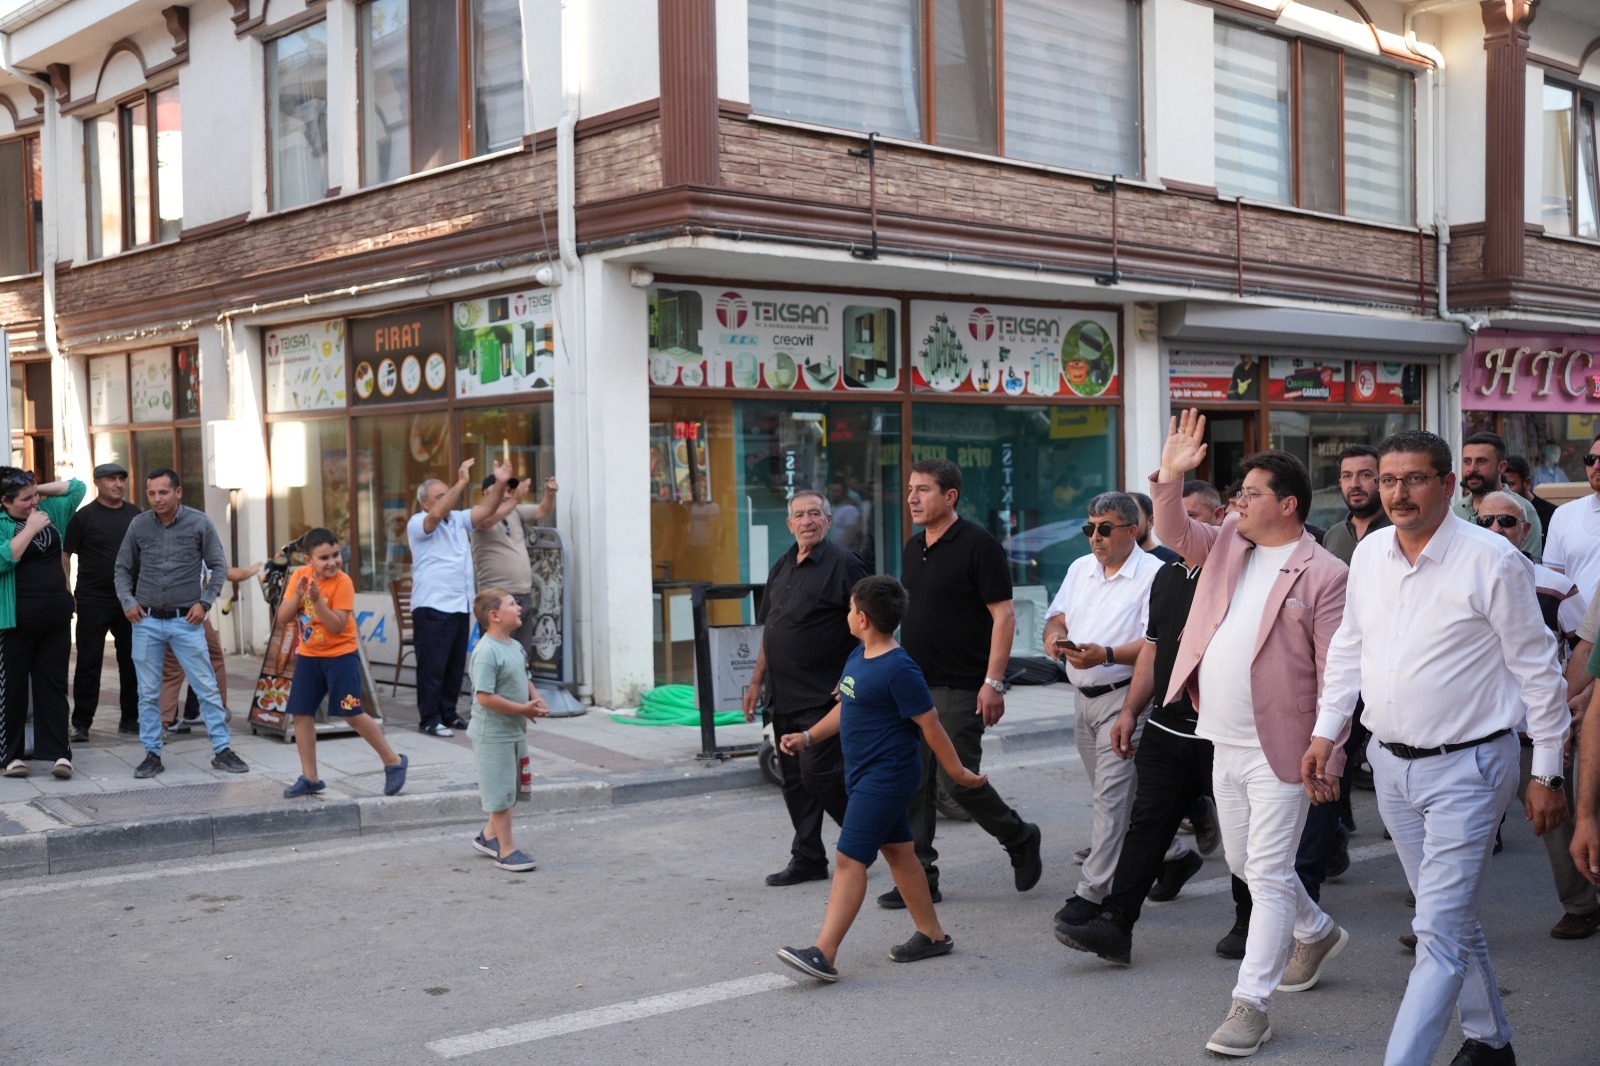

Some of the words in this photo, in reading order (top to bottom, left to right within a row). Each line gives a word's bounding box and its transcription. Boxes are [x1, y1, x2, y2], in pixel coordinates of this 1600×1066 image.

[752, 301, 829, 325] TEKSAN
[375, 322, 421, 352] FIRAT
[997, 316, 1060, 337] TEKSAN
[280, 333, 310, 351] TEKSAN
[773, 334, 814, 347] creavit
[1481, 346, 1593, 396] HTC
